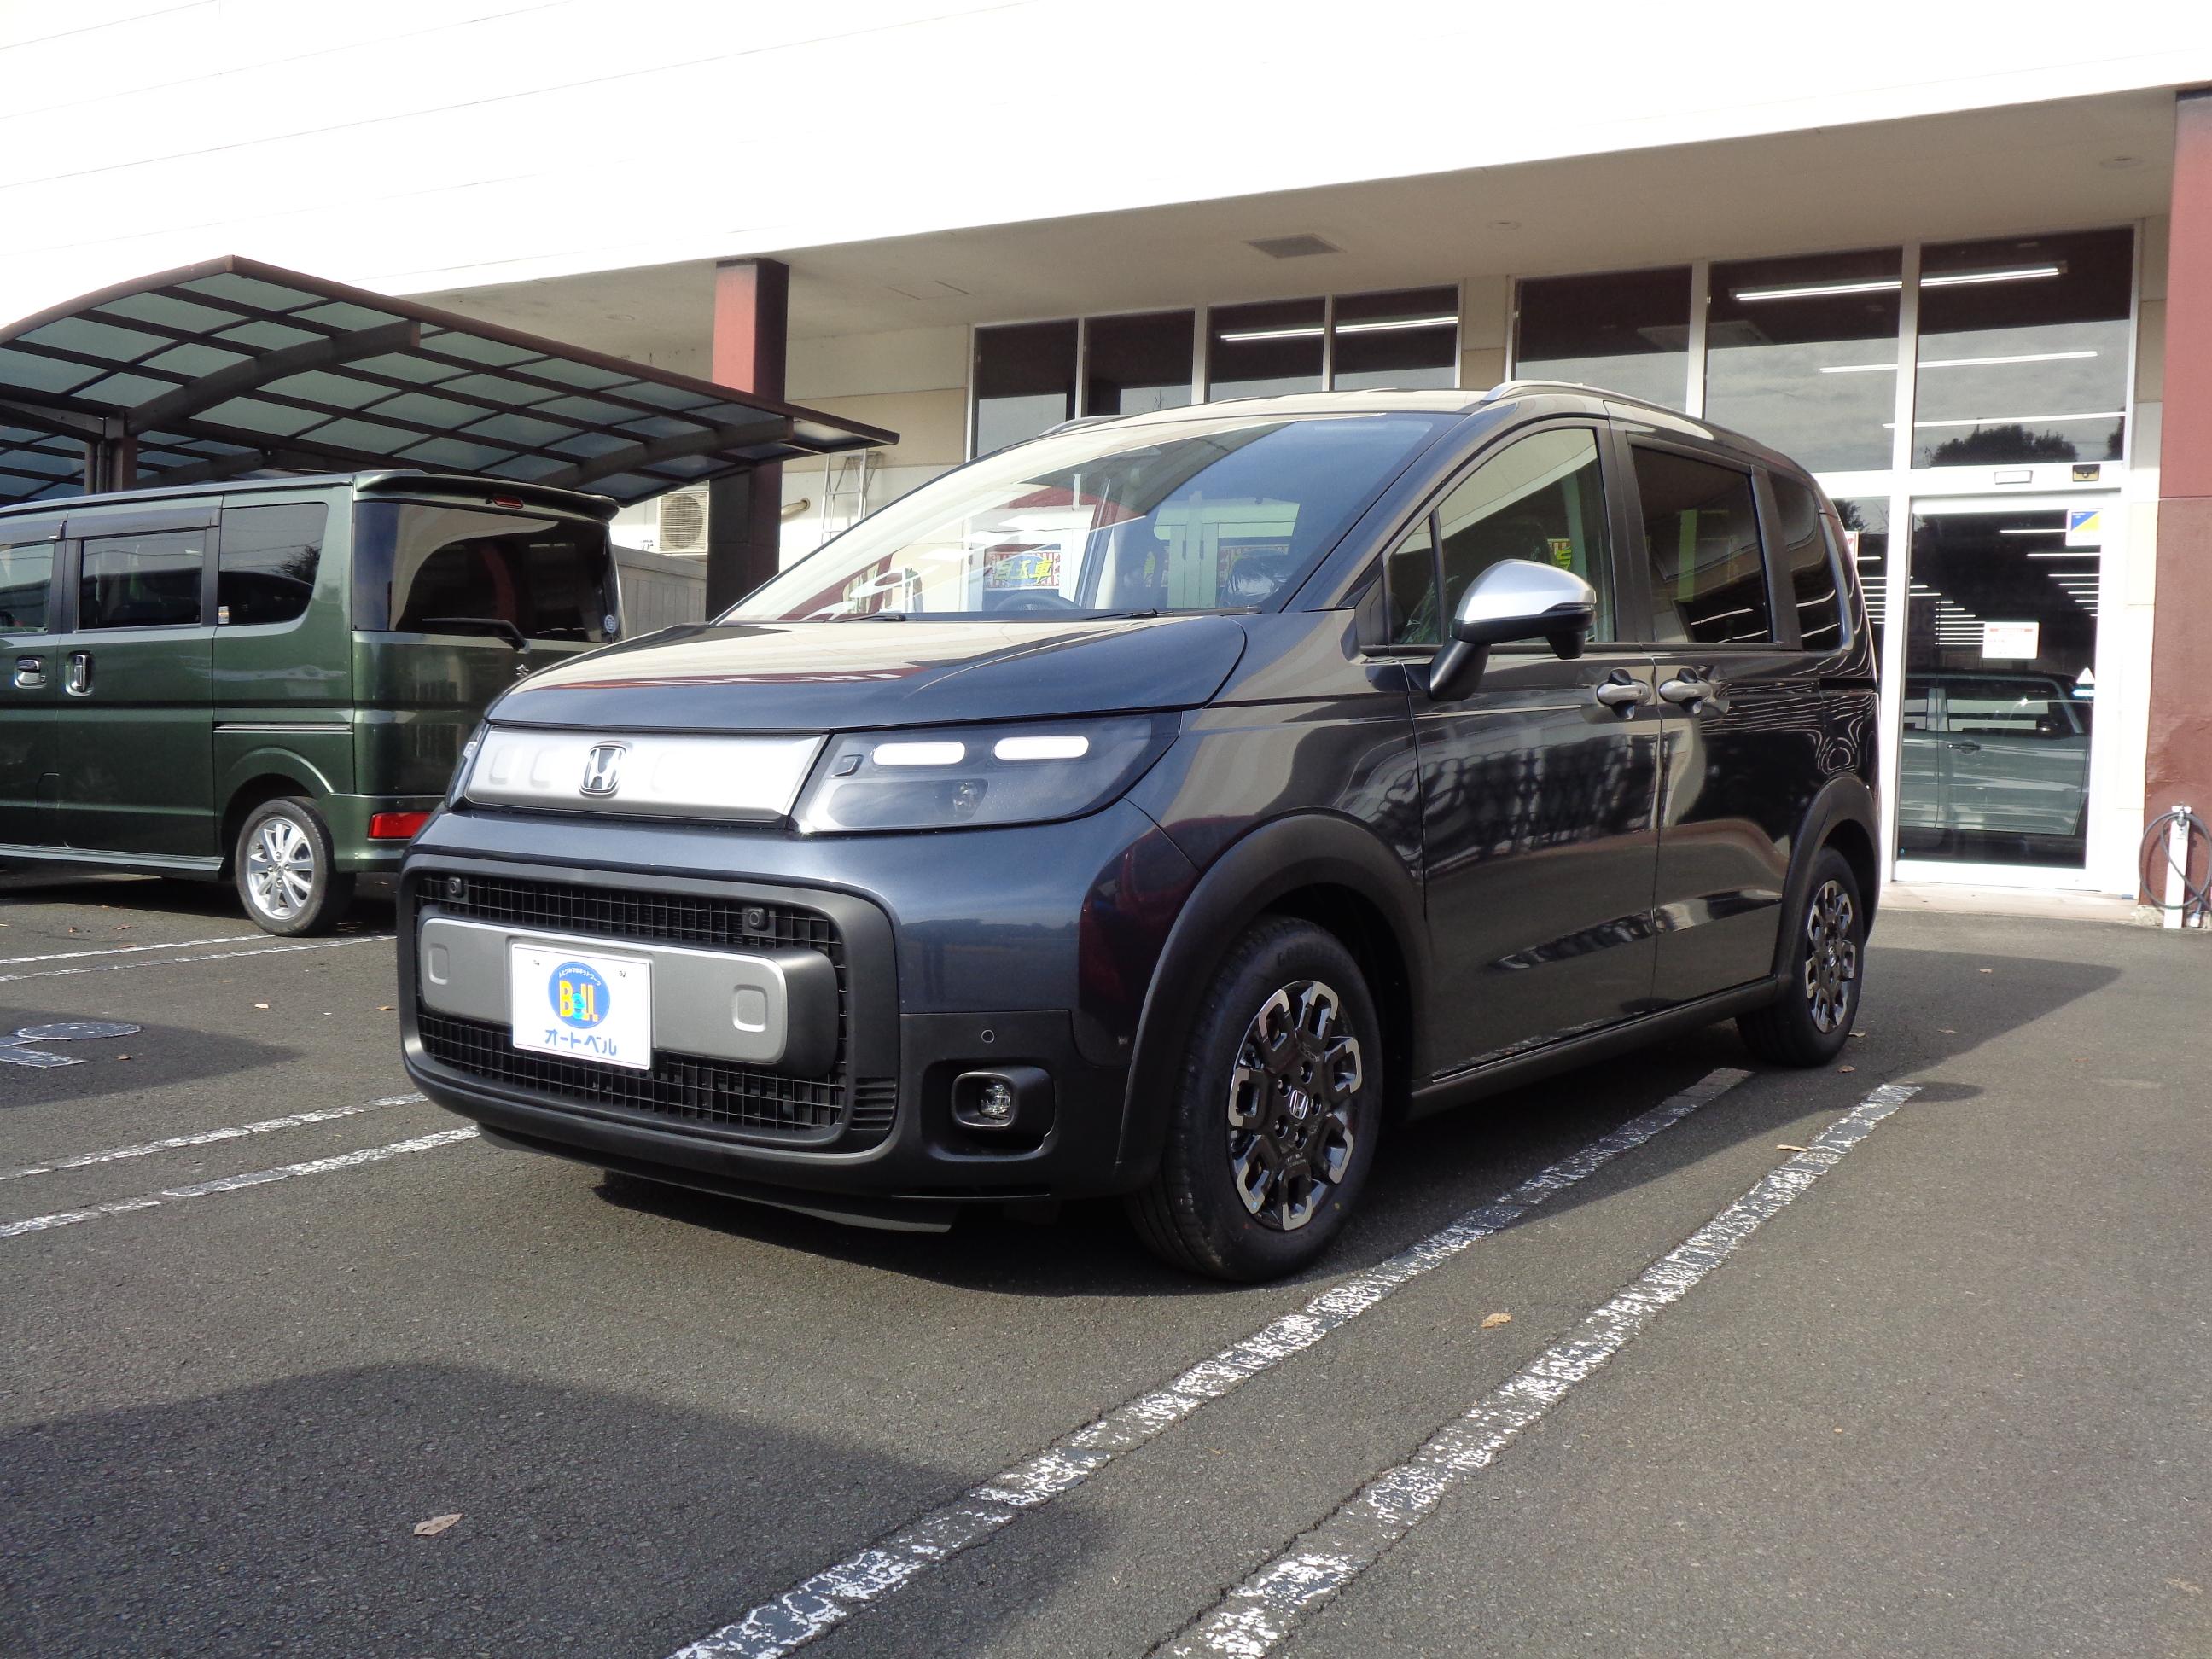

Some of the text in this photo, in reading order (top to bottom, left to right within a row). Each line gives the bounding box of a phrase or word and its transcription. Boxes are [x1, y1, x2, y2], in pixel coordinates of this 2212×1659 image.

[545, 1030, 617, 1056] オートベル
